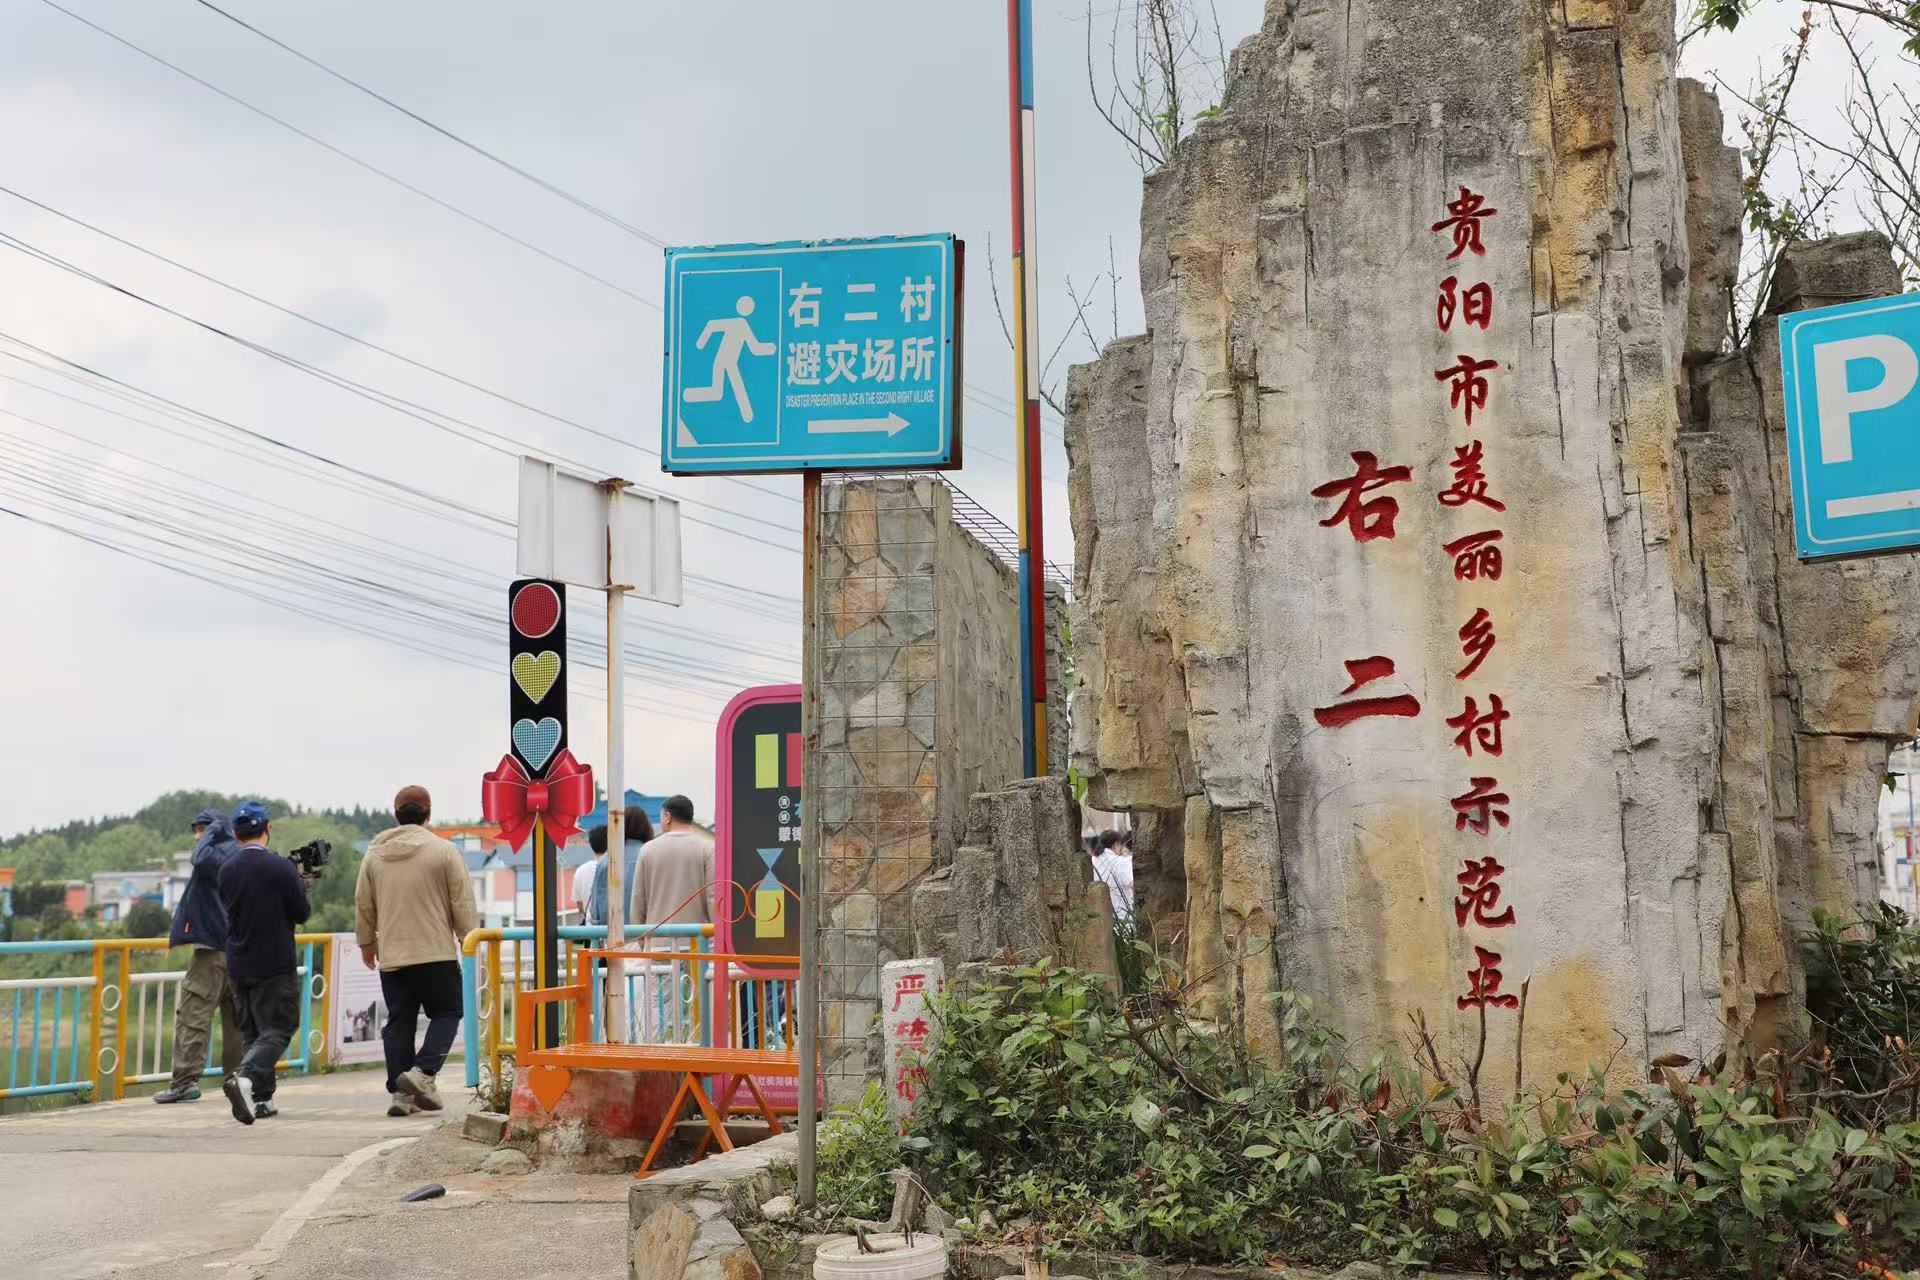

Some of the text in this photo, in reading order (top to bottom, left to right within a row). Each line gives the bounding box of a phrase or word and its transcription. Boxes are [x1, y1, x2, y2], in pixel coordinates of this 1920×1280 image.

[787, 275, 936, 328] 右二村
[786, 336, 935, 386] 避灾场所
[786, 394, 810, 408] DISASTER
[811, 393, 842, 407] PREVENTION
[843, 392, 859, 406] PLACE
[865, 391, 876, 404] THE
[876, 391, 896, 404] SECOND
[897, 390, 912, 403] RIGHT
[914, 389, 934, 402] VILLAGE
[1813, 334, 1920, 464] P
[1311, 450, 1420, 727] 右二
[1432, 185, 1519, 1010] 贵阳市美丽乡村示范点
